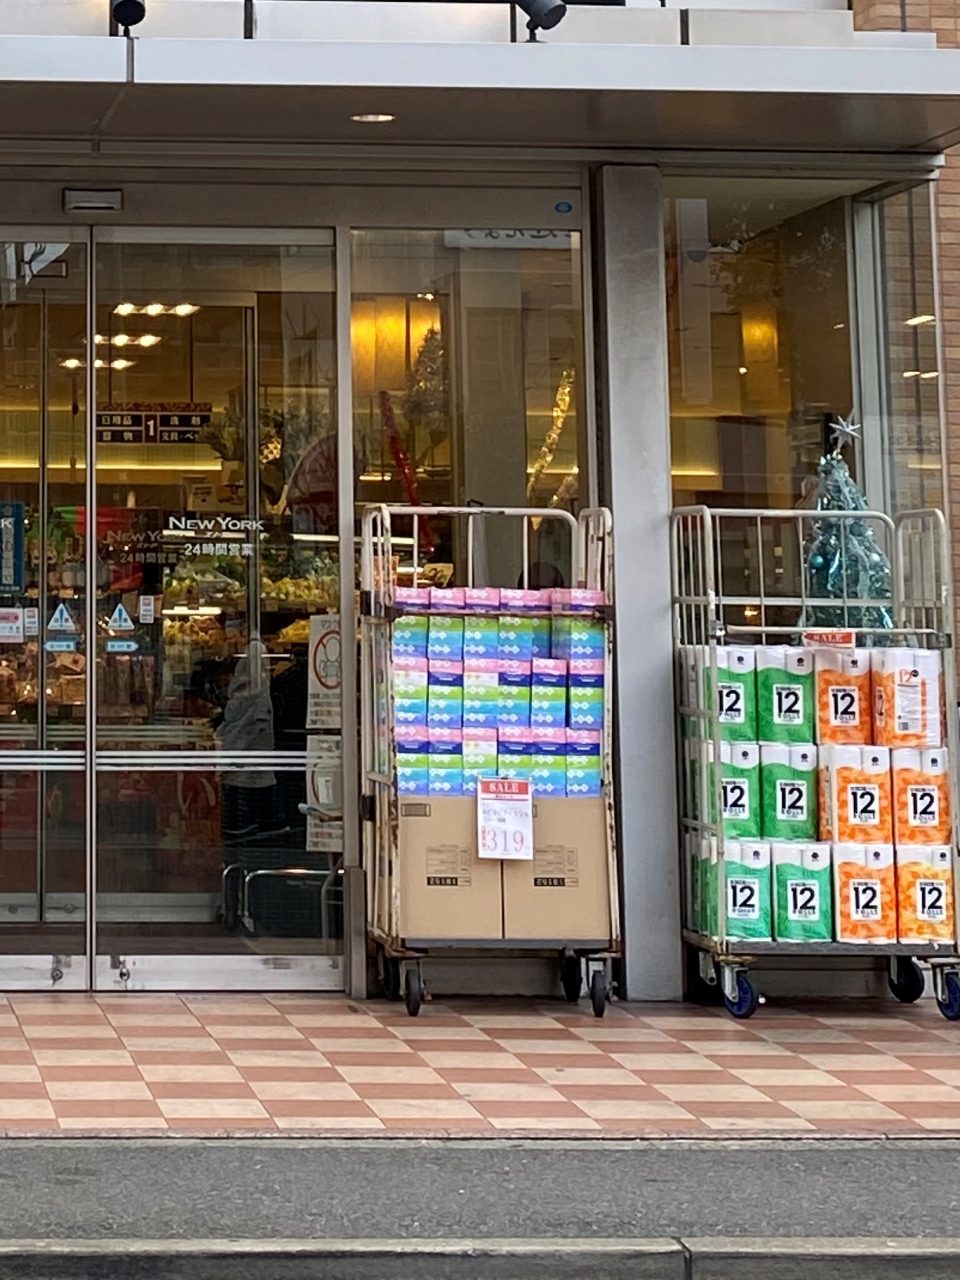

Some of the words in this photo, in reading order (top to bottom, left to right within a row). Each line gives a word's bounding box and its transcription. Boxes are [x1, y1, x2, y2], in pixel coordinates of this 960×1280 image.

[146, 419, 154, 436] 1
[216, 517, 264, 530] YORK
[184, 543, 254, 556] 24時間営業
[776, 691, 800, 713] 12
[832, 693, 855, 715] 12
[489, 782, 520, 793] SALE
[722, 785, 746, 808] 12
[781, 787, 804, 809] 12
[851, 791, 875, 814] 12
[911, 792, 935, 815] 12
[487, 829, 524, 853] 319
[731, 885, 755, 908] 12
[791, 887, 816, 909] 12
[853, 886, 878, 909] 12
[920, 887, 943, 910] 12
